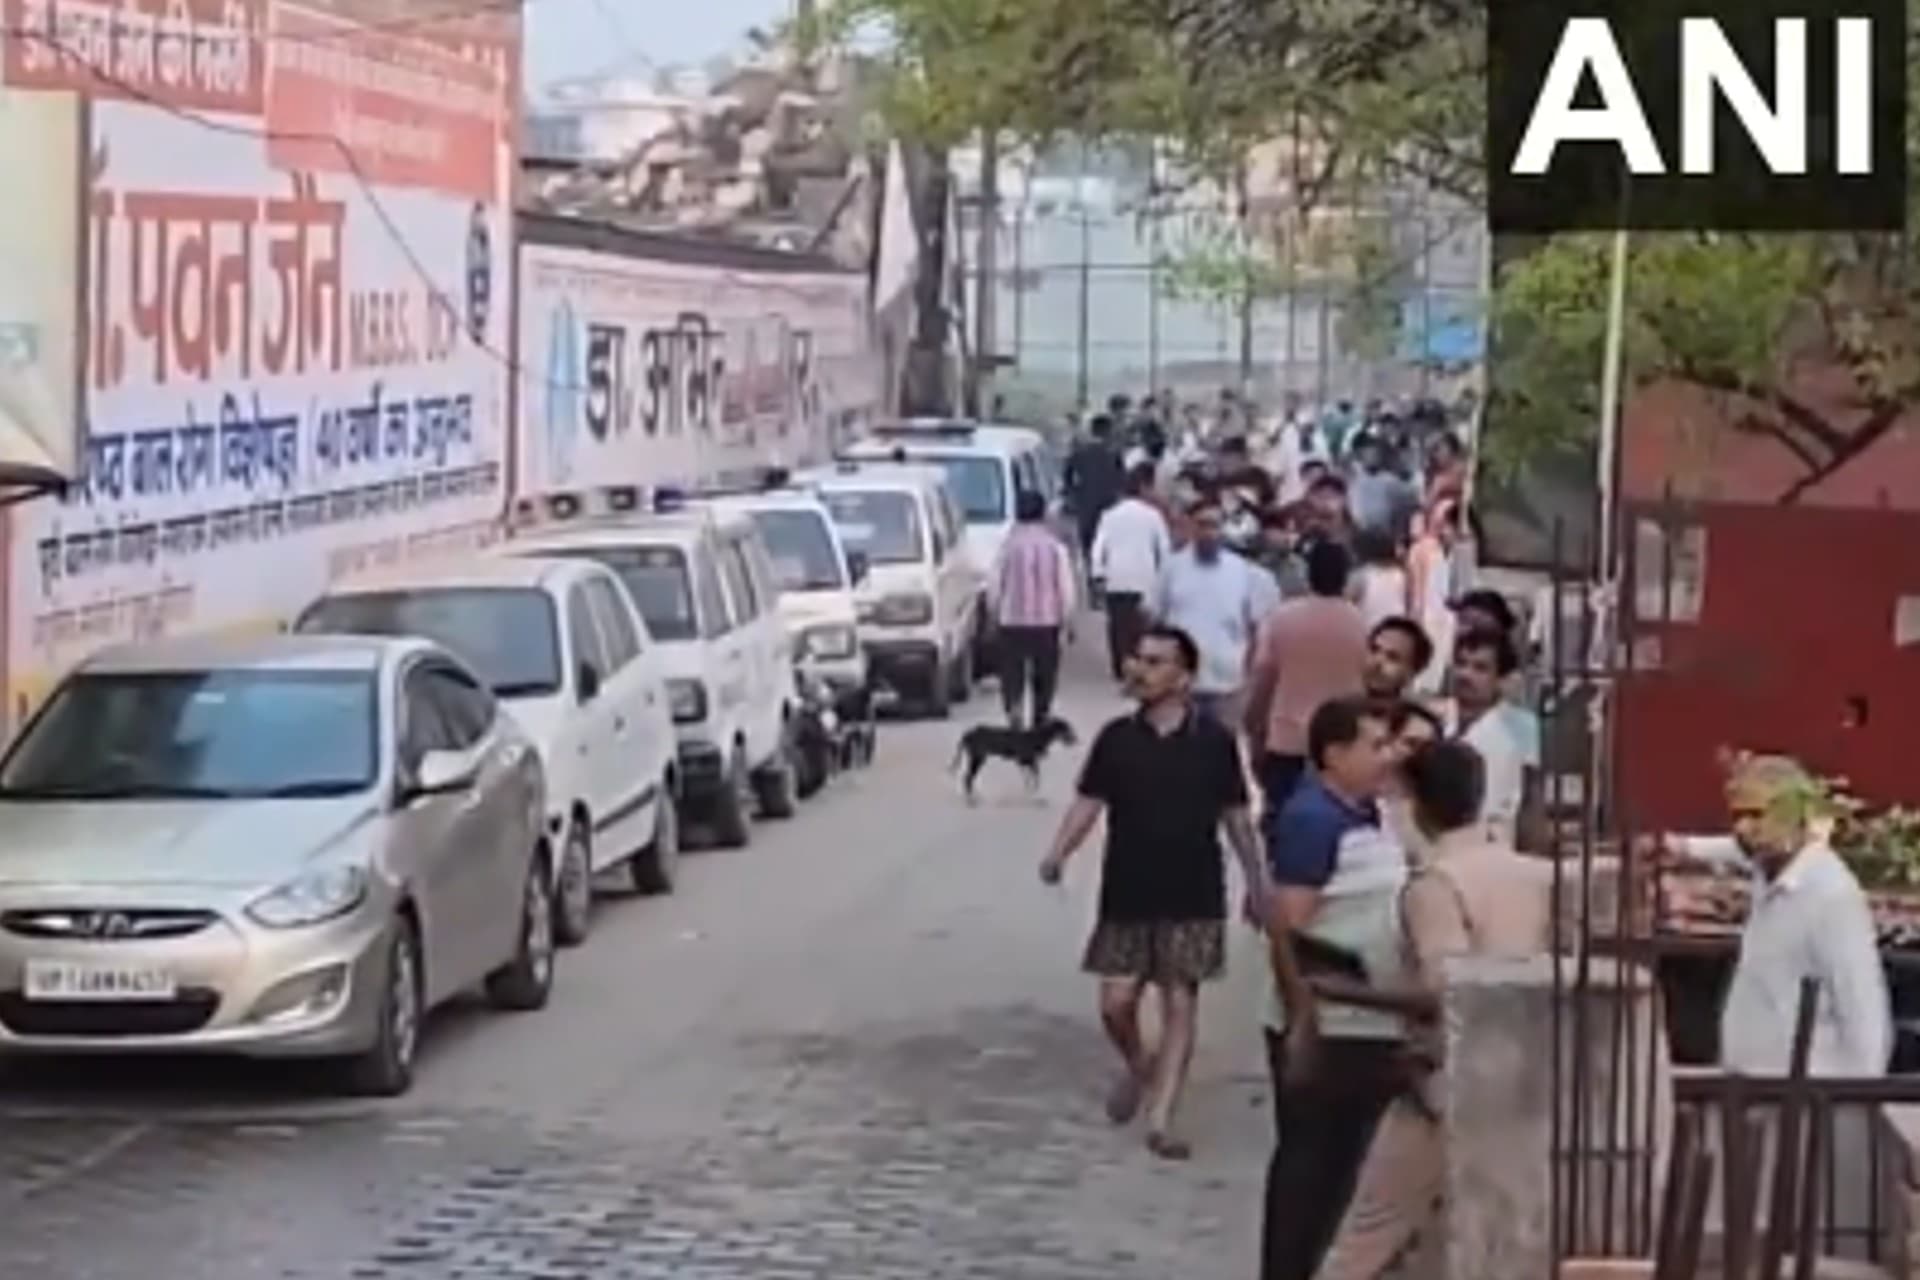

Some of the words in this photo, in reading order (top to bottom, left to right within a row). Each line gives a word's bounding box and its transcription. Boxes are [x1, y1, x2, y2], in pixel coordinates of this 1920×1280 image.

[124, 191, 259, 385] पवन
[261, 170, 346, 375] जैन
[132, 427, 172, 494] बाल
[175, 398, 215, 493] रोग
